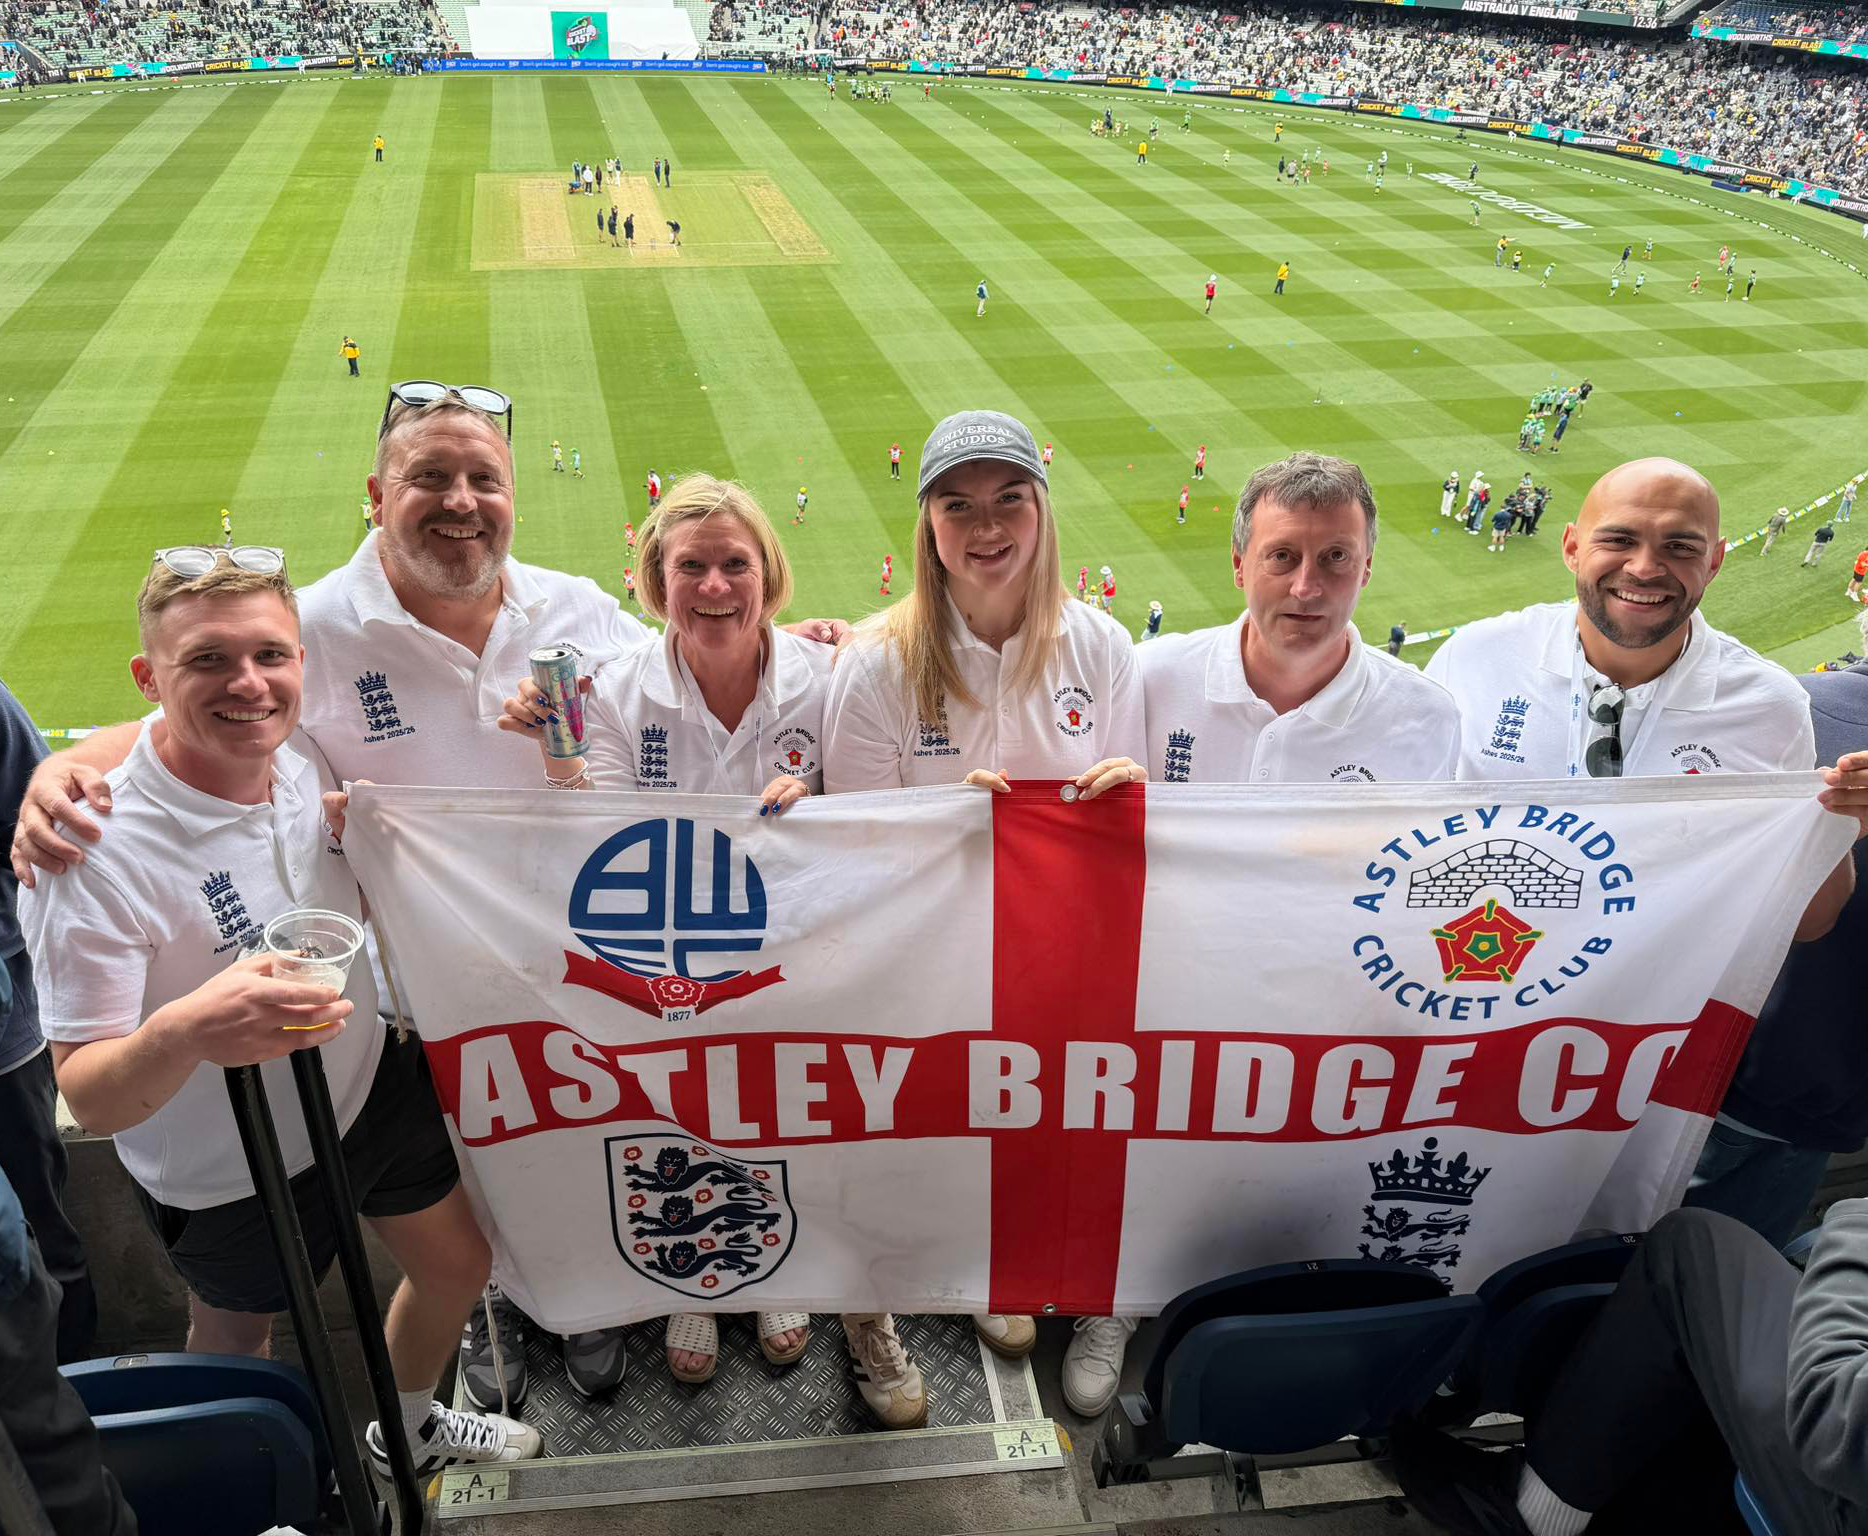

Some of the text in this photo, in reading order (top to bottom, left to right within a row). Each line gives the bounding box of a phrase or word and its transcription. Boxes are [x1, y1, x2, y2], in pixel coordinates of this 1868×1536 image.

[1461, 1, 1578, 21] AUSTRALIA V ENGLAND
[1726, 33, 1822, 49] WOOLWORTHS CRICKET BLAST
[205, 59, 231, 70] CRICKET
[232, 60, 252, 70] BLAST
[295, 56, 337, 67] WOOLWORTHS
[1230, 89, 1257, 97] CRICKET
[1357, 103, 1385, 111] CRICKET
[1385, 105, 1404, 114] BLAST
[1446, 115, 1534, 133] WOOLWORTHS CRICKET BLAST
[1574, 136, 1662, 158] WOOLWORTHS CRICKET BLAST
[1703, 164, 1790, 189] WOOLWORTHS CRICKET BLAST
[936, 425, 1014, 447] UNIVERSAL
[943, 434, 1006, 453] STUDIOS
[1053, 686, 1093, 704] ASTLEY BRIDGE
[364, 726, 416, 743] Ashes 2025/26
[773, 728, 792, 745] ASTLEY
[796, 728, 816, 745] BRIDGE
[1056, 721, 1080, 737] CRICKET
[934, 747, 961, 756] 2025/26
[1499, 752, 1525, 763] 2025/26
[1671, 743, 1721, 768] ASTLEY BRIDGE
[773, 761, 816, 776] CRICKET CLUB
[1330, 764, 1356, 779] ASTLEY
[1352, 804, 1637, 915] ASTLEY BRIDGE
[213, 940, 238, 955] Ashes
[1353, 935, 1613, 1021] CRICKET CLUB
[667, 1011, 691, 1022] 1877
[460, 1030, 915, 1140] ASTLEY
[968, 1039, 1478, 1135] BRIDGE
[1020, 1430, 1032, 1443] A
[470, 1473, 483, 1487] A
